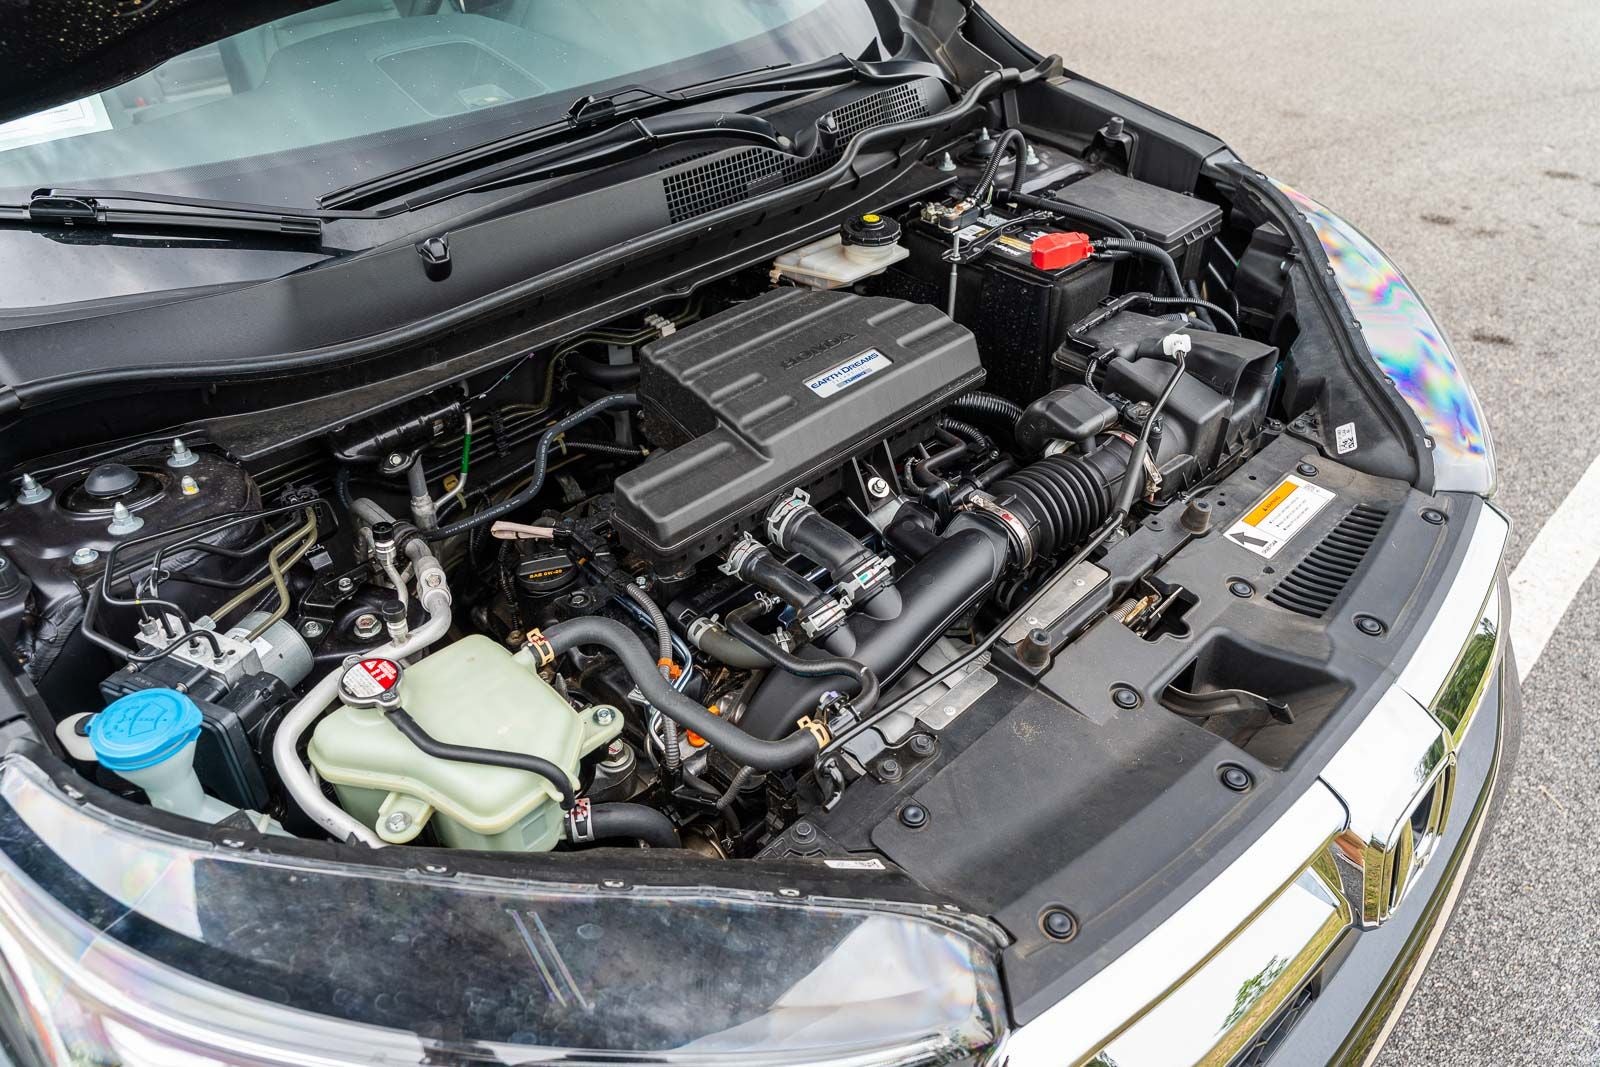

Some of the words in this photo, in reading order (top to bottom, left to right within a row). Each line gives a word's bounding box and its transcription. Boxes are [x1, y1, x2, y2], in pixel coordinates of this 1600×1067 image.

[782, 332, 857, 370] HONDA
[811, 370, 842, 389] EARTH
[841, 352, 879, 375] DREAMS
